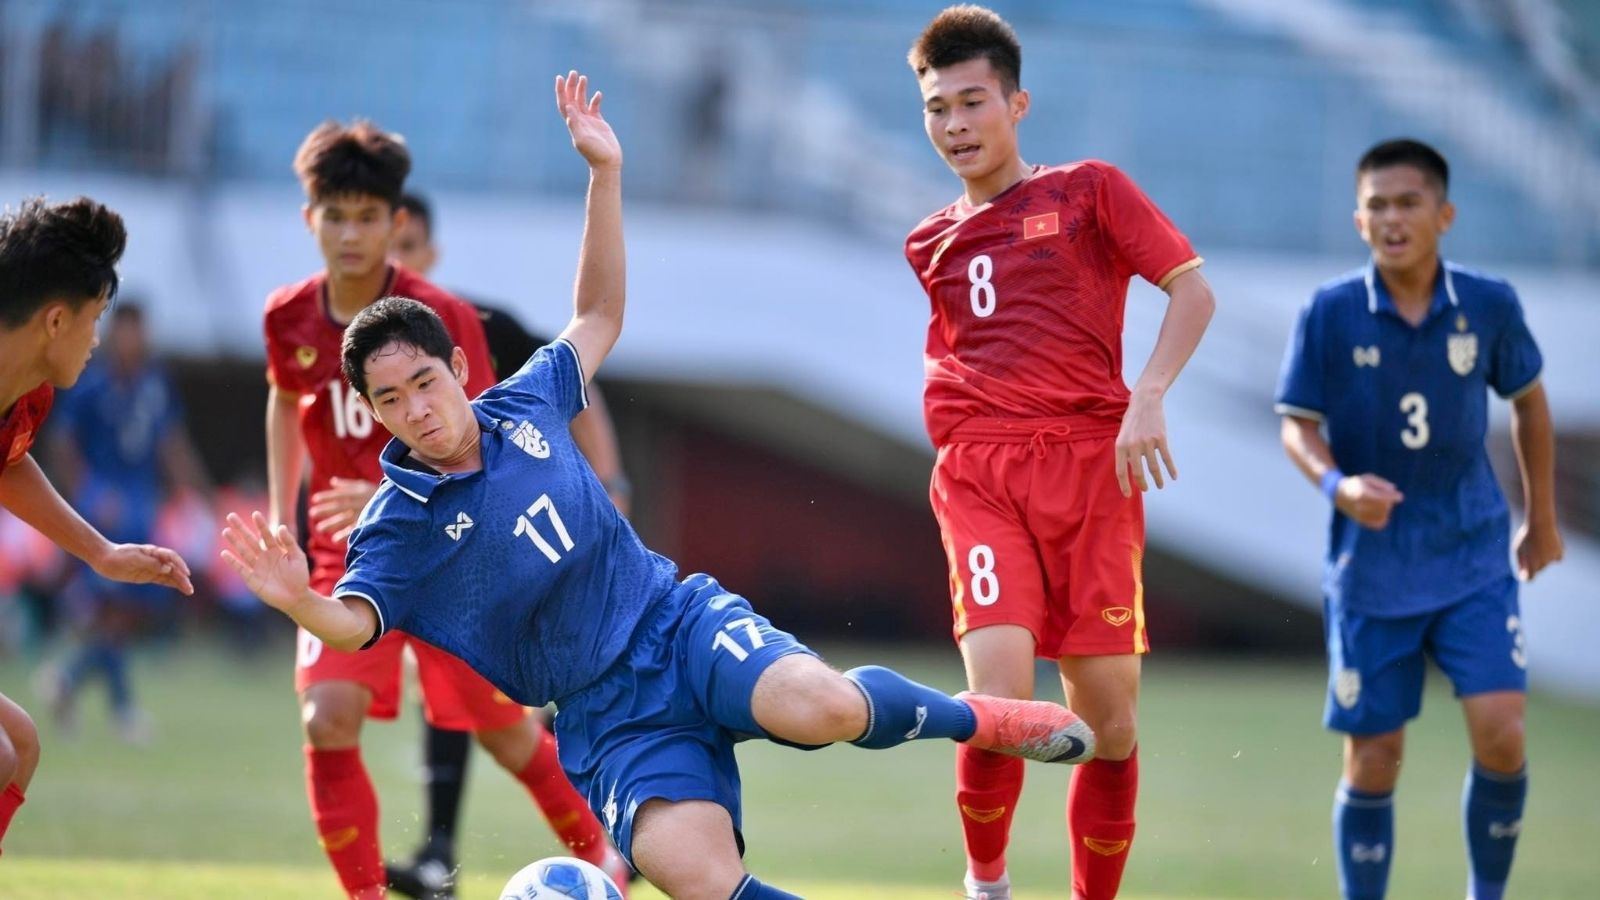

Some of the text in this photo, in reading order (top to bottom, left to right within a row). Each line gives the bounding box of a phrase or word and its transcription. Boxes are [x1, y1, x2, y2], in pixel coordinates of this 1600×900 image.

[968, 255, 996, 318] 8
[328, 379, 373, 439] 16
[1400, 392, 1430, 449] 3
[513, 493, 575, 564] 17
[968, 544, 1000, 606] 8
[711, 617, 766, 662] 17
[1506, 615, 1528, 669] 3
